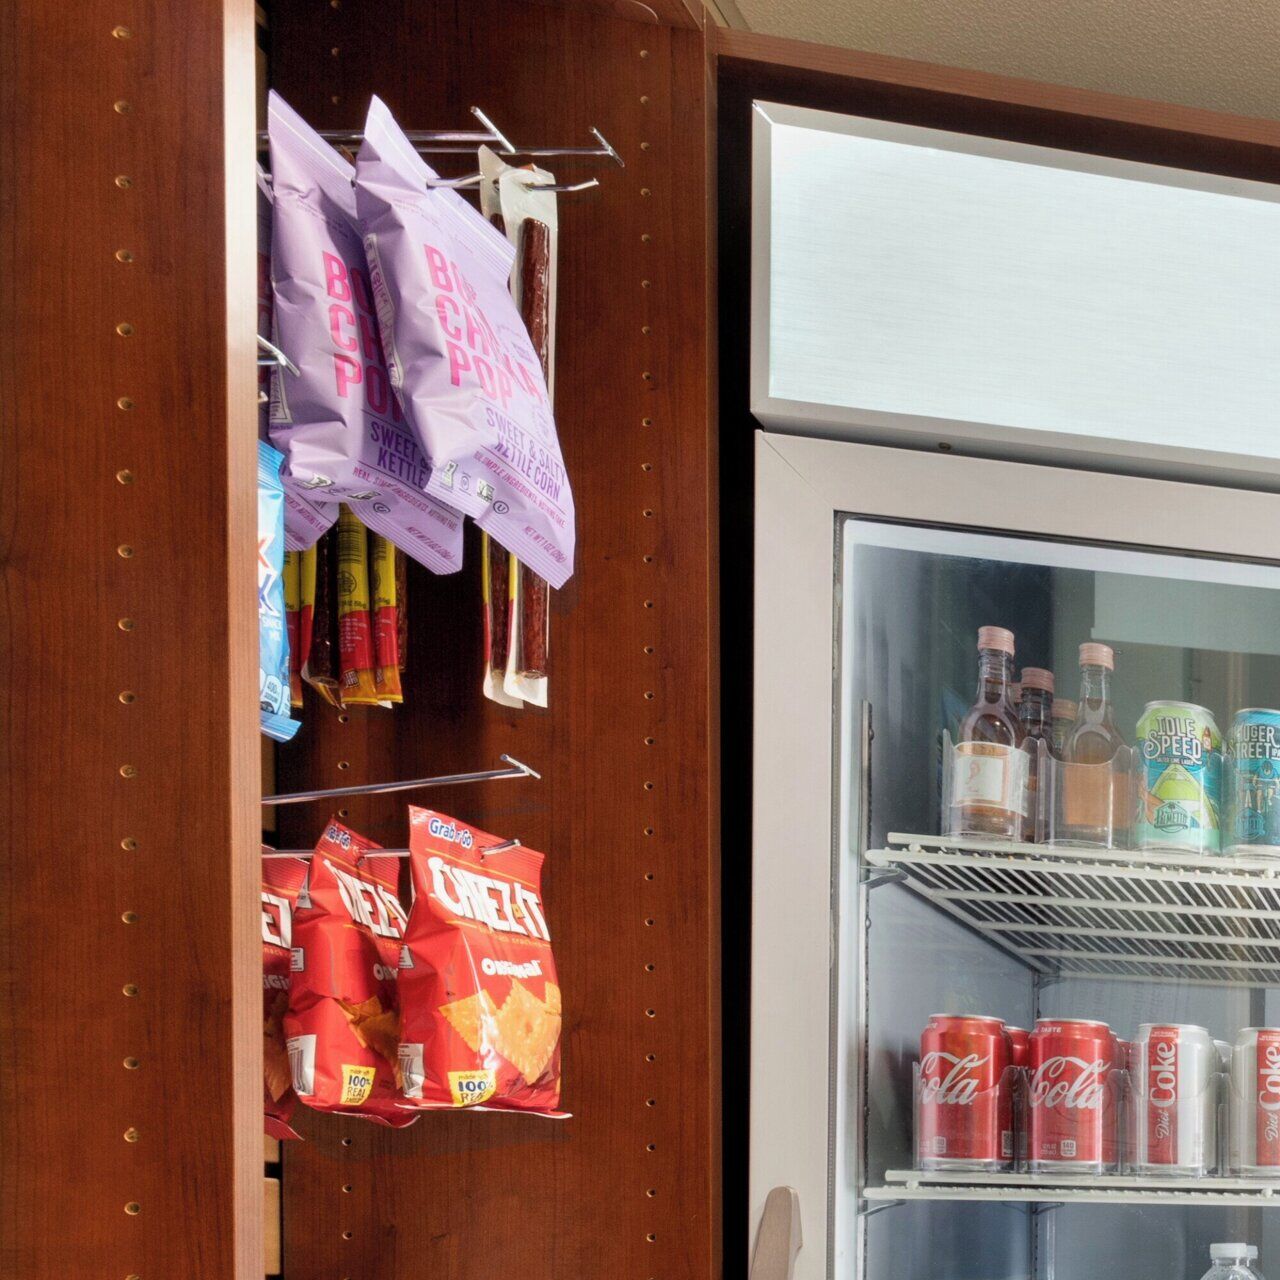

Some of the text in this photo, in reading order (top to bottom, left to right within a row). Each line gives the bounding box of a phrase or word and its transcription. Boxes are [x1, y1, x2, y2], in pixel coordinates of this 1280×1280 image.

[377, 447, 429, 489] KETTLE
[1157, 716, 1197, 740] IDLE
[1143, 730, 1203, 761] SPEED
[1229, 740, 1271, 759] STREET
[429, 818, 455, 839] Grab
[347, 1074, 371, 1089] 100%
[1150, 1041, 1177, 1107] Coke
[347, 1087, 366, 1099] REAL
[1156, 1109, 1170, 1140] Diet
[1265, 1112, 1278, 1142] Diet
